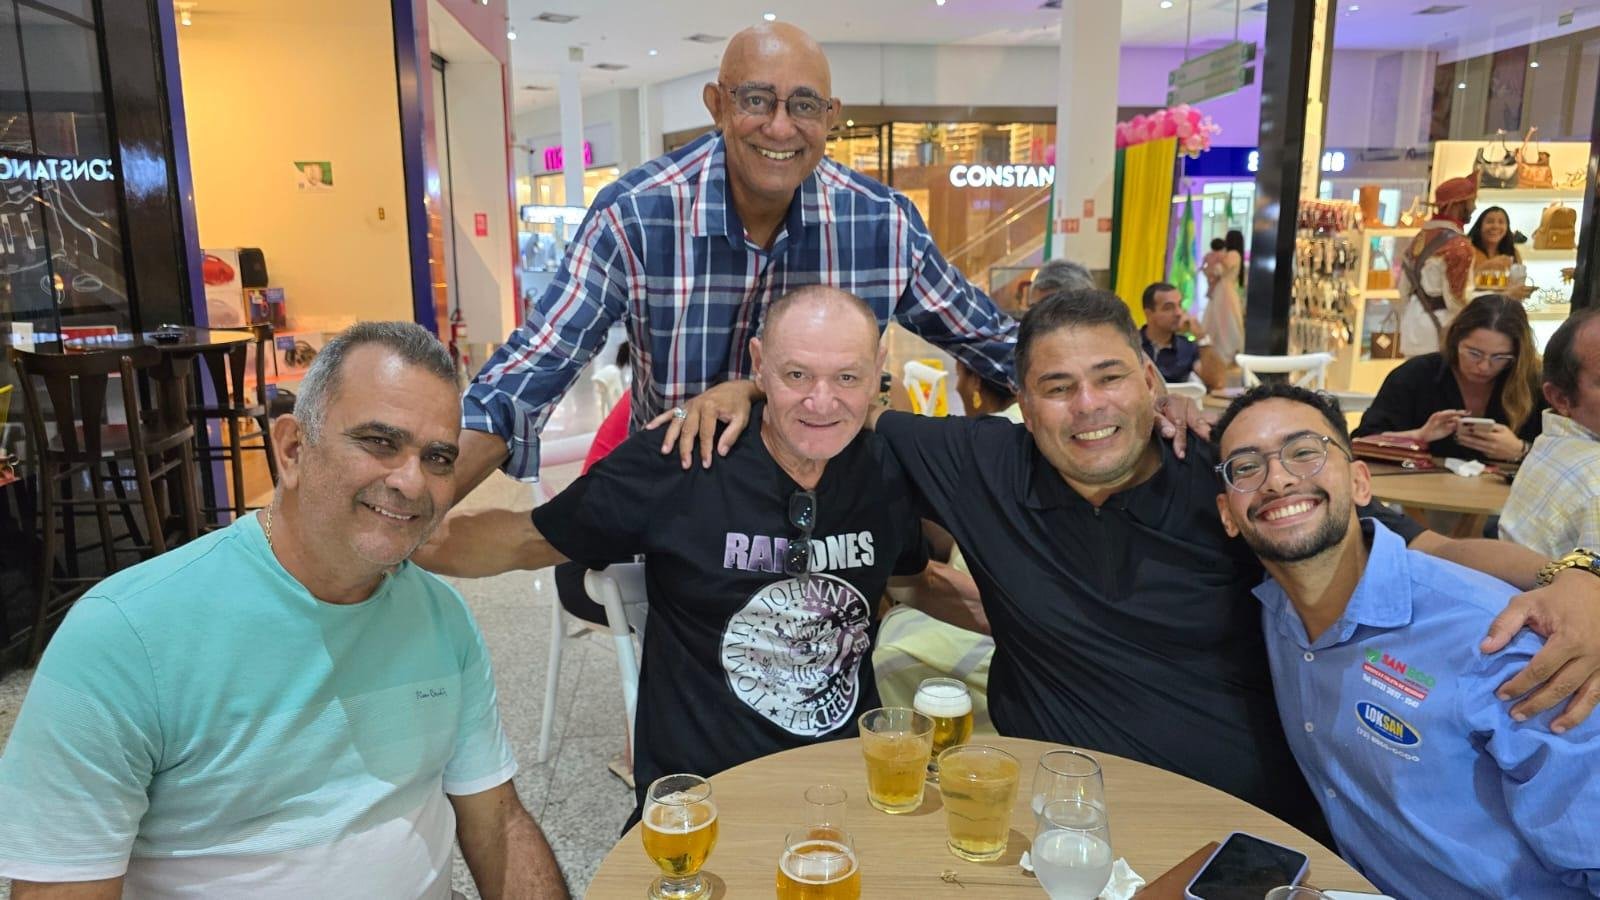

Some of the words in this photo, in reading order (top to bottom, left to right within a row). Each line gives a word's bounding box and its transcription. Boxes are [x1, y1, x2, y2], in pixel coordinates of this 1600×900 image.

[949, 164, 1056, 188] CONSTAN
[760, 579, 859, 614] JOHNNY
[726, 613, 767, 712] TOMMY
[1364, 703, 1404, 737] LOKSAN
